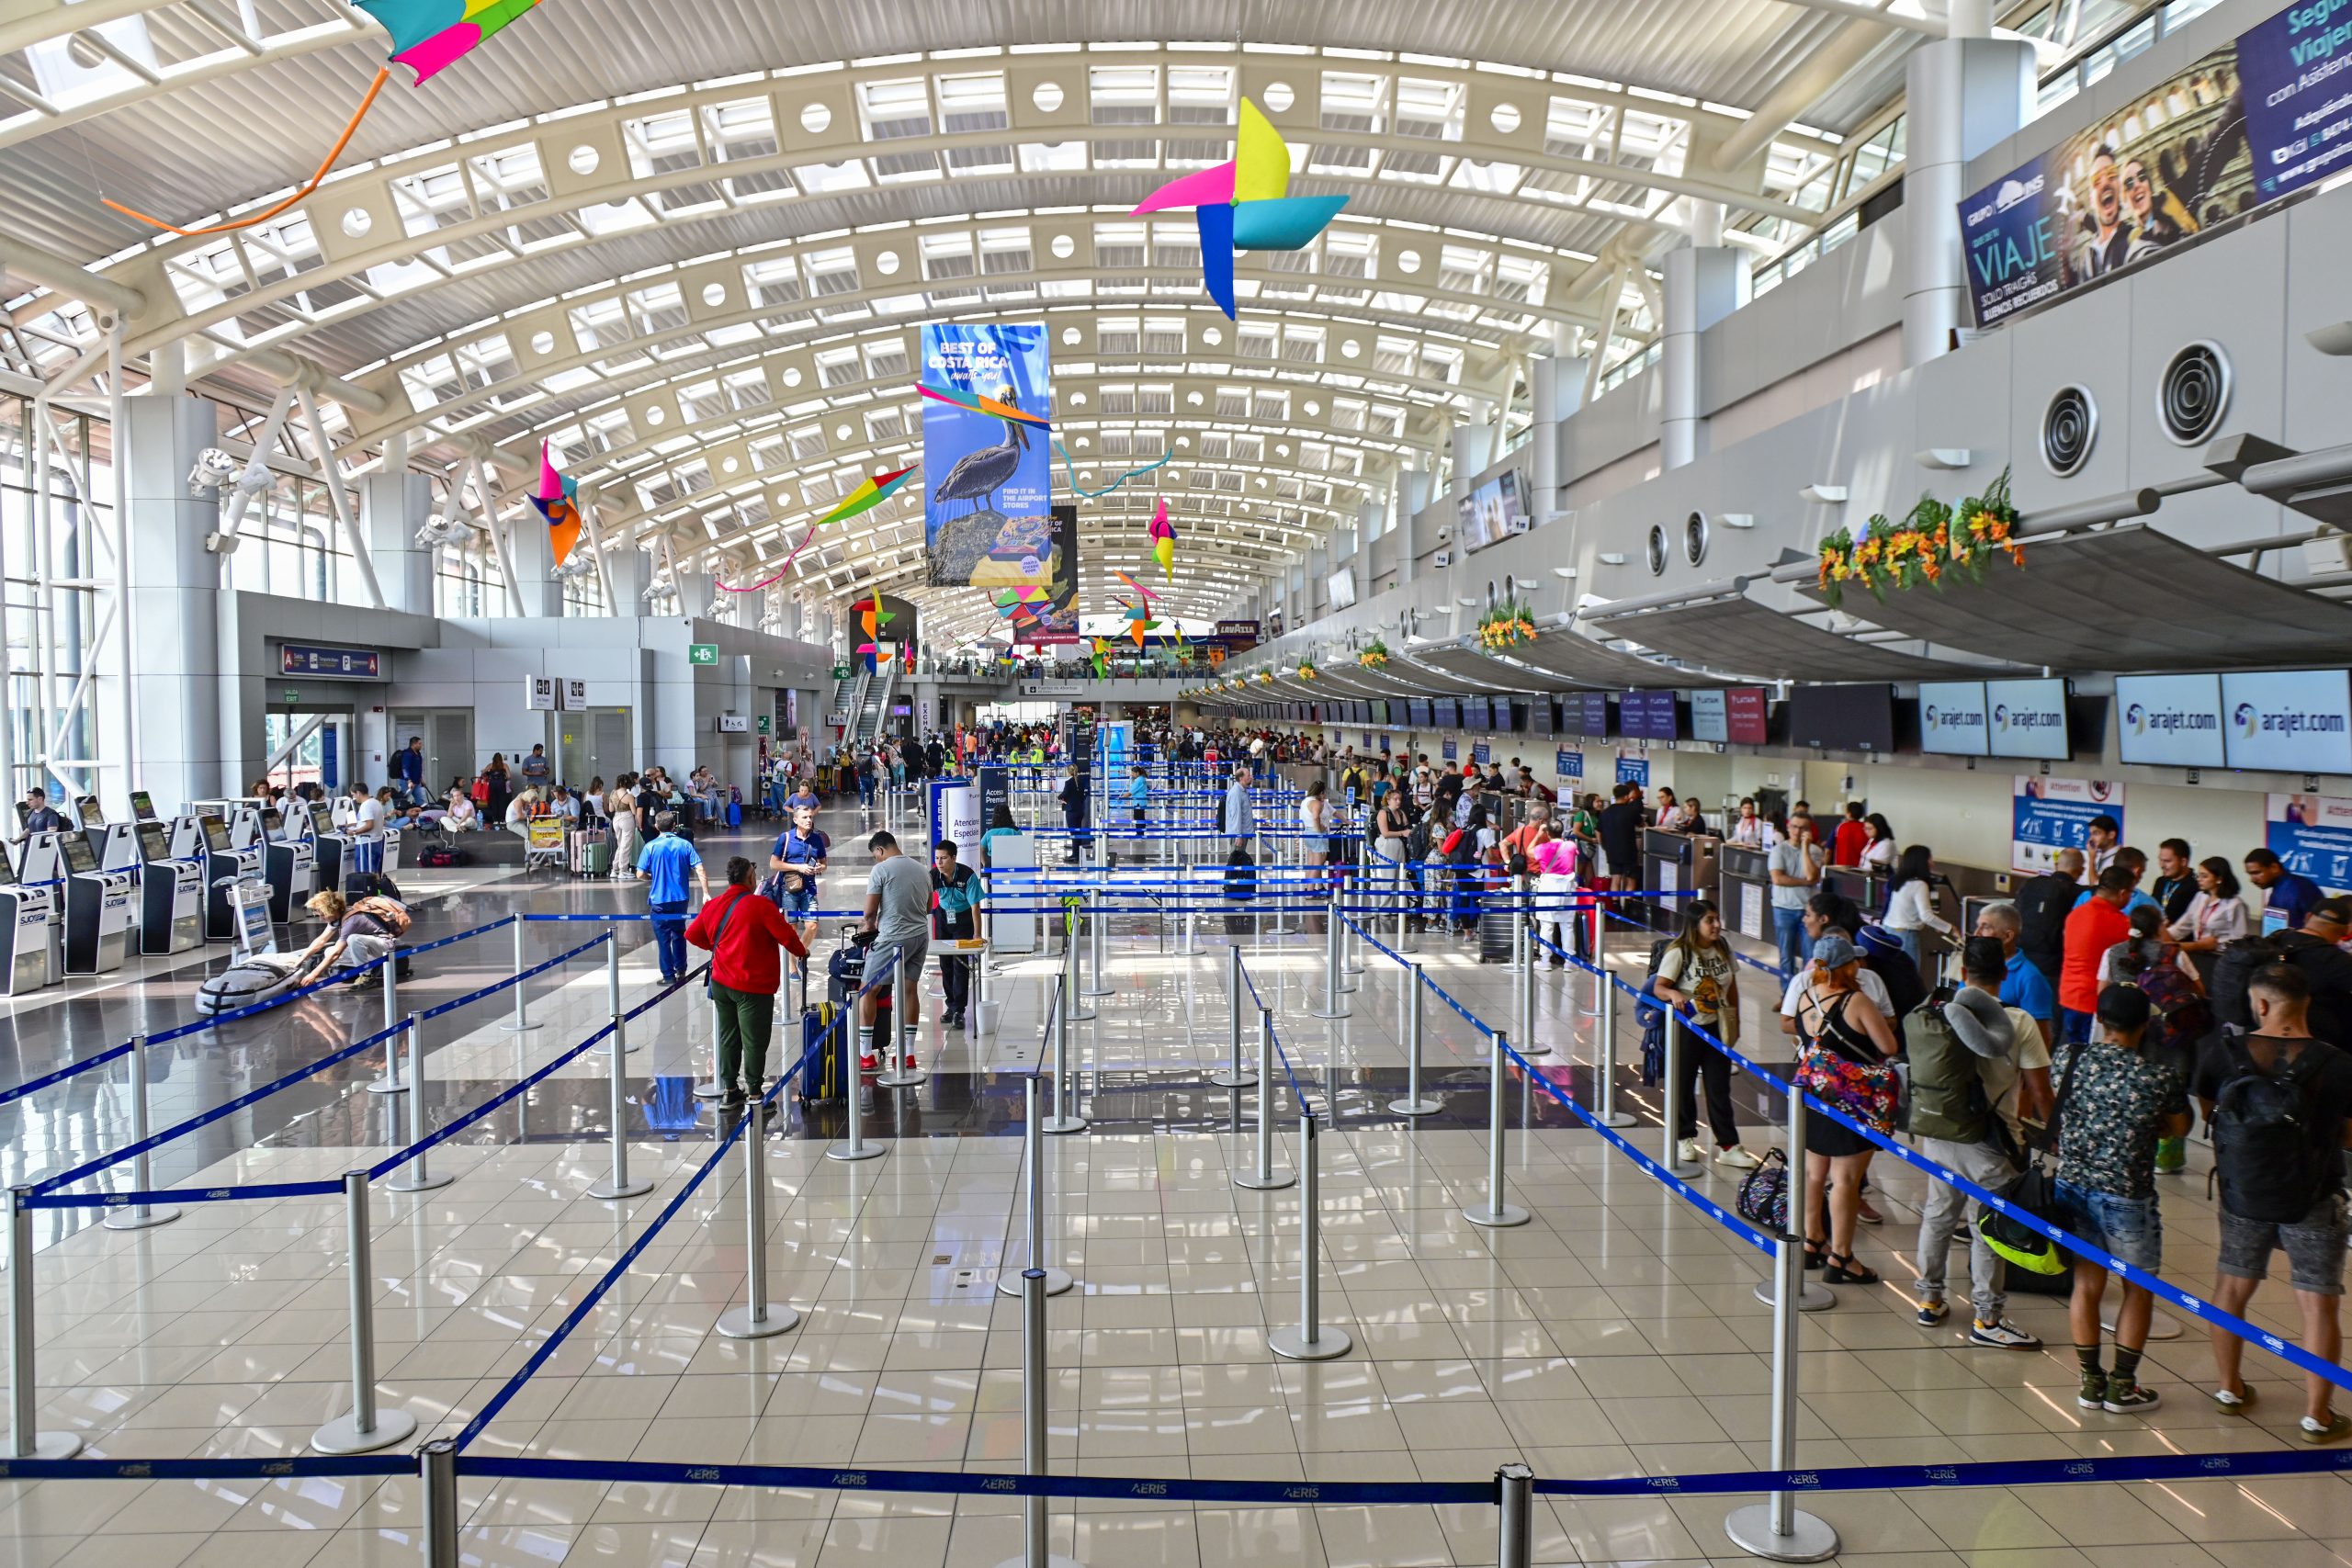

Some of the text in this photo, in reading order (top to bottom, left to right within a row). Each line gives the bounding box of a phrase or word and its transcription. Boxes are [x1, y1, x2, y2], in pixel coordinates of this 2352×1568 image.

[2288, 0, 2348, 35] Segu
[1967, 204, 1994, 227] GRUPO
[1973, 216, 2056, 287] VIAJE
[1981, 288, 2003, 307] SOLO
[1984, 278, 2059, 321] BUENOS RECUERDOS
[941, 343, 996, 355] BEST OF
[928, 356, 1009, 369] COSTA RICA
[951, 368, 1001, 382] awaits you!
[1220, 624, 1255, 634] LAVAZZA
[285, 653, 292, 665] A
[344, 658, 348, 668] P
[369, 660, 376, 670] A
[1940, 706, 1983, 730] arajet.com
[2012, 706, 2062, 732] arajet.com
[2150, 706, 2216, 735] arajet.com
[2262, 706, 2345, 738] arajet.com
[2050, 782, 2081, 793] Attention
[954, 818, 979, 827] Atencione
[954, 829, 979, 839] Especiale
[105, 1195, 129, 1203] AERIS
[206, 1190, 231, 1198] AERIS
[260, 1462, 294, 1475] AERIS
[2064, 1462, 2094, 1474] AERIS
[2200, 1457, 2231, 1468] AERIS
[119, 1463, 151, 1476] AERIS
[685, 1468, 720, 1481] AERIS
[1925, 1468, 1957, 1479] AERIS
[831, 1473, 867, 1485] AERIS
[979, 1478, 1016, 1490] AERIS
[1646, 1477, 1679, 1487] AERIS
[1788, 1473, 1819, 1484] AERIS
[1131, 1483, 1167, 1495] AERIS
[1283, 1487, 1318, 1498] AERIS
